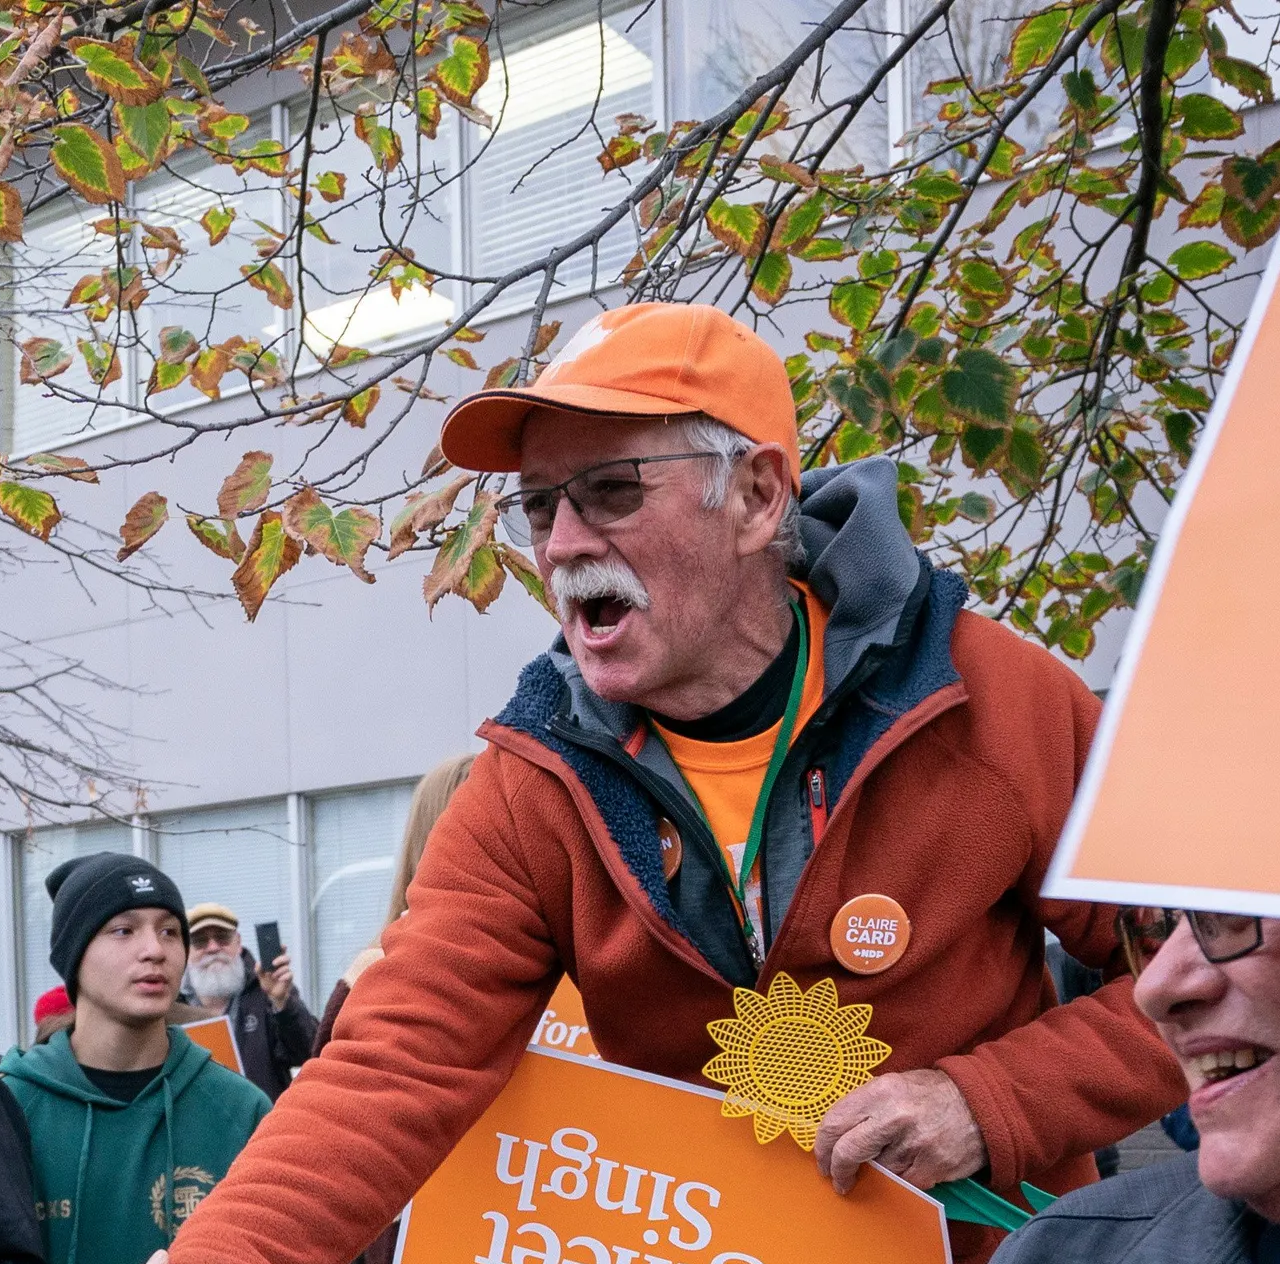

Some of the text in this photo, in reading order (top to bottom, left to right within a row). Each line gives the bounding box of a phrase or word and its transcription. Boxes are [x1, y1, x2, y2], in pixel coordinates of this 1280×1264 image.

[847, 915, 899, 932] CLAIRE
[845, 928, 896, 946] CARD
[861, 950, 884, 959] NDP
[530, 1009, 590, 1048] for
[494, 1127, 720, 1252] Singh
